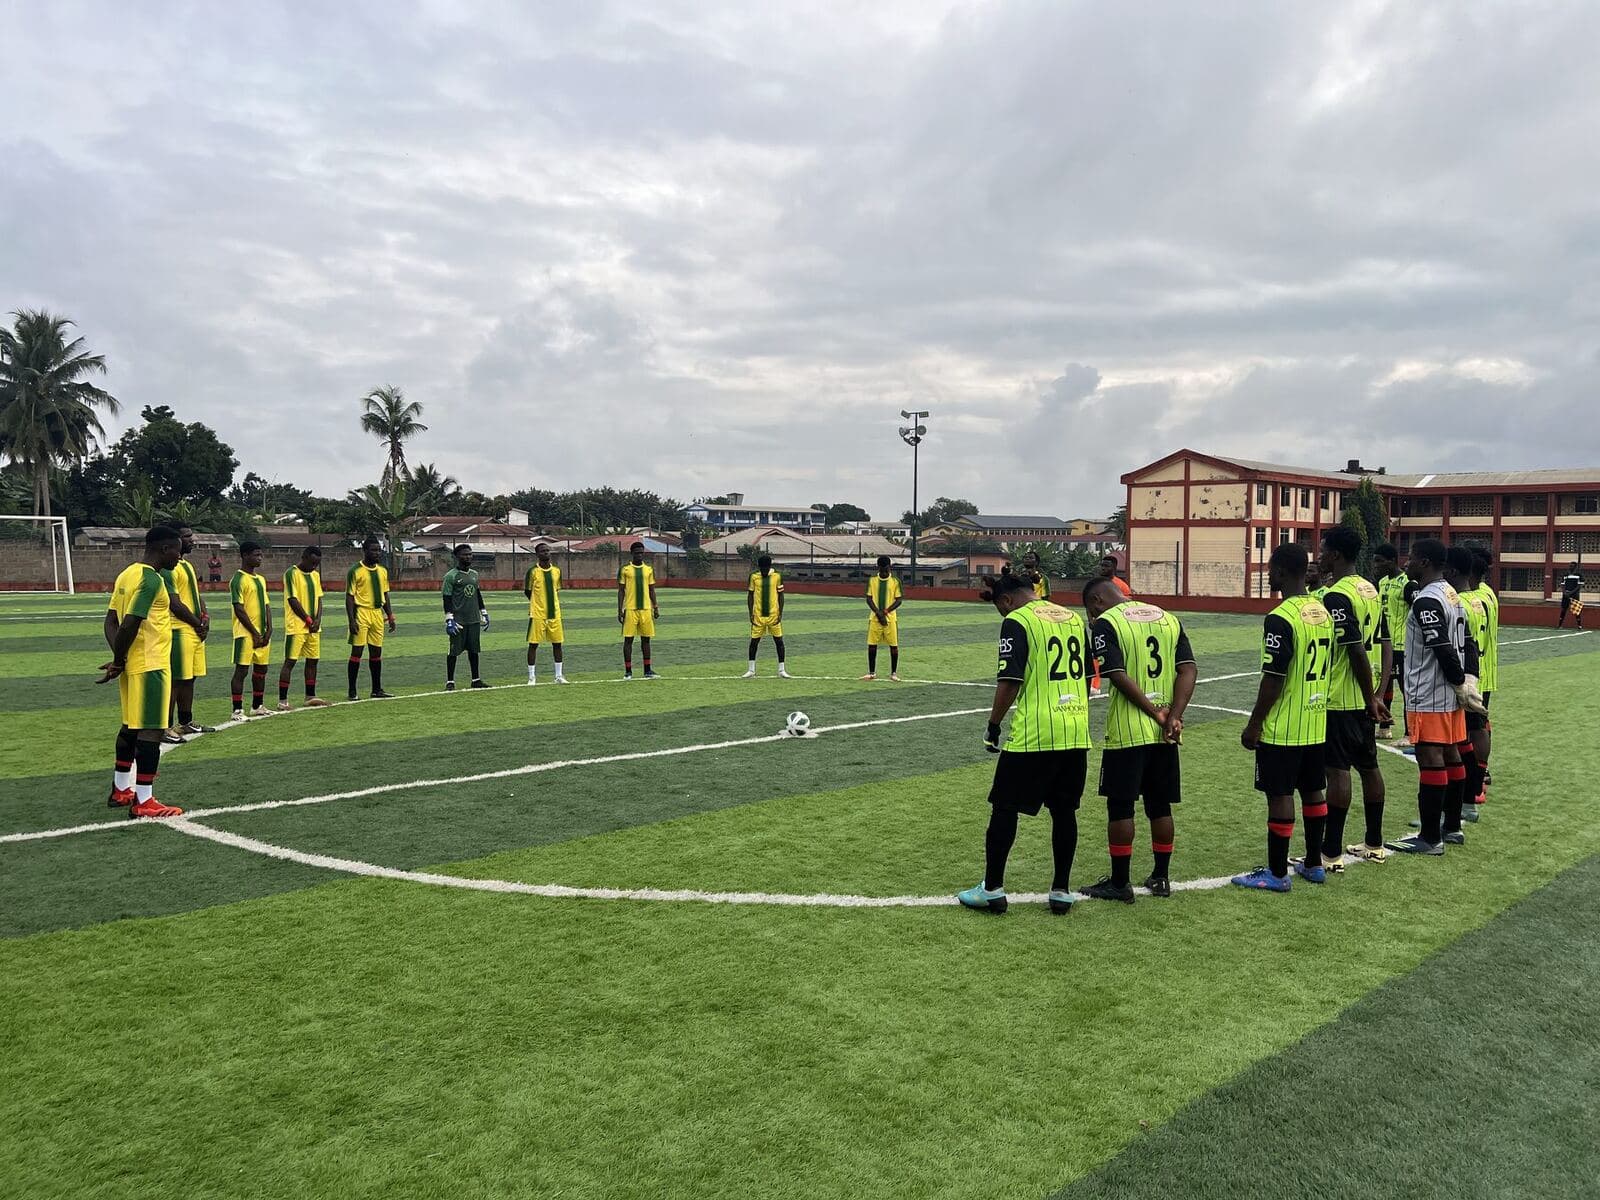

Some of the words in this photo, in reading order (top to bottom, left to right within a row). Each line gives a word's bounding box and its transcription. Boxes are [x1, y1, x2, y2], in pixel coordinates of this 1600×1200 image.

[1331, 608, 1347, 621] BS
[999, 638, 1014, 653] BS
[1094, 634, 1106, 650] BS
[1266, 633, 1283, 648] BS
[1048, 635, 1083, 680] 28
[1146, 635, 1163, 678] 3
[1305, 638, 1330, 681] 27
